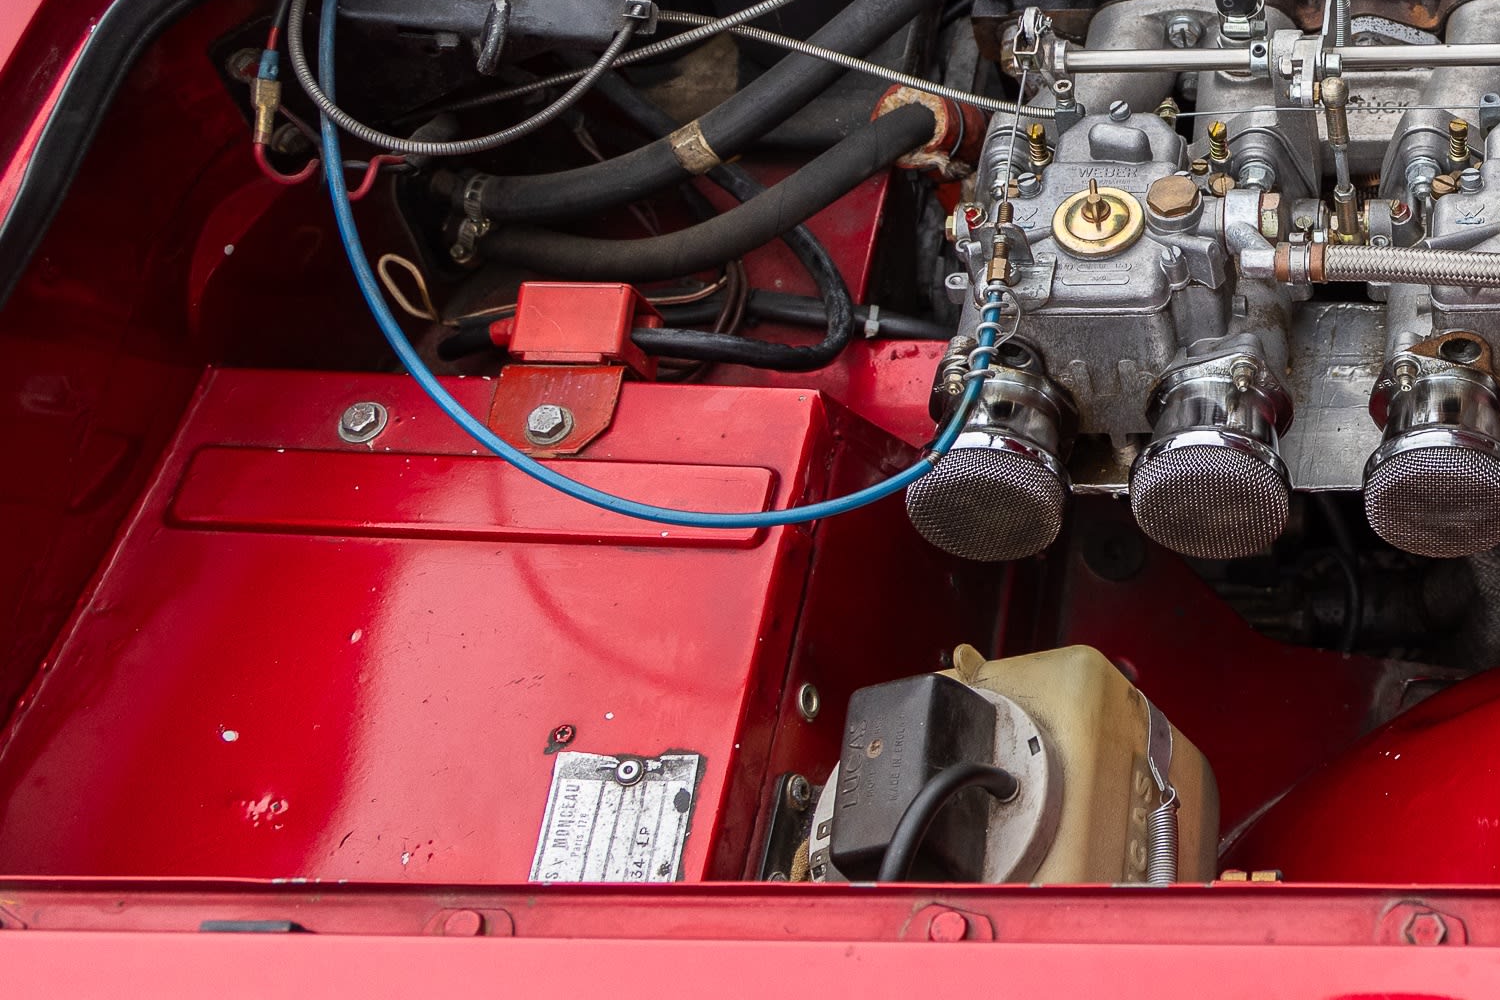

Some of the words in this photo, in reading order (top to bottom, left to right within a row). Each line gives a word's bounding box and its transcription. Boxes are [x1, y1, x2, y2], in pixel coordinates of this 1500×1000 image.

[1079, 167, 1138, 178] WEBER
[842, 719, 867, 809] LUCAS
[552, 784, 581, 848] MONCEAU
[571, 835, 584, 857] Paris
